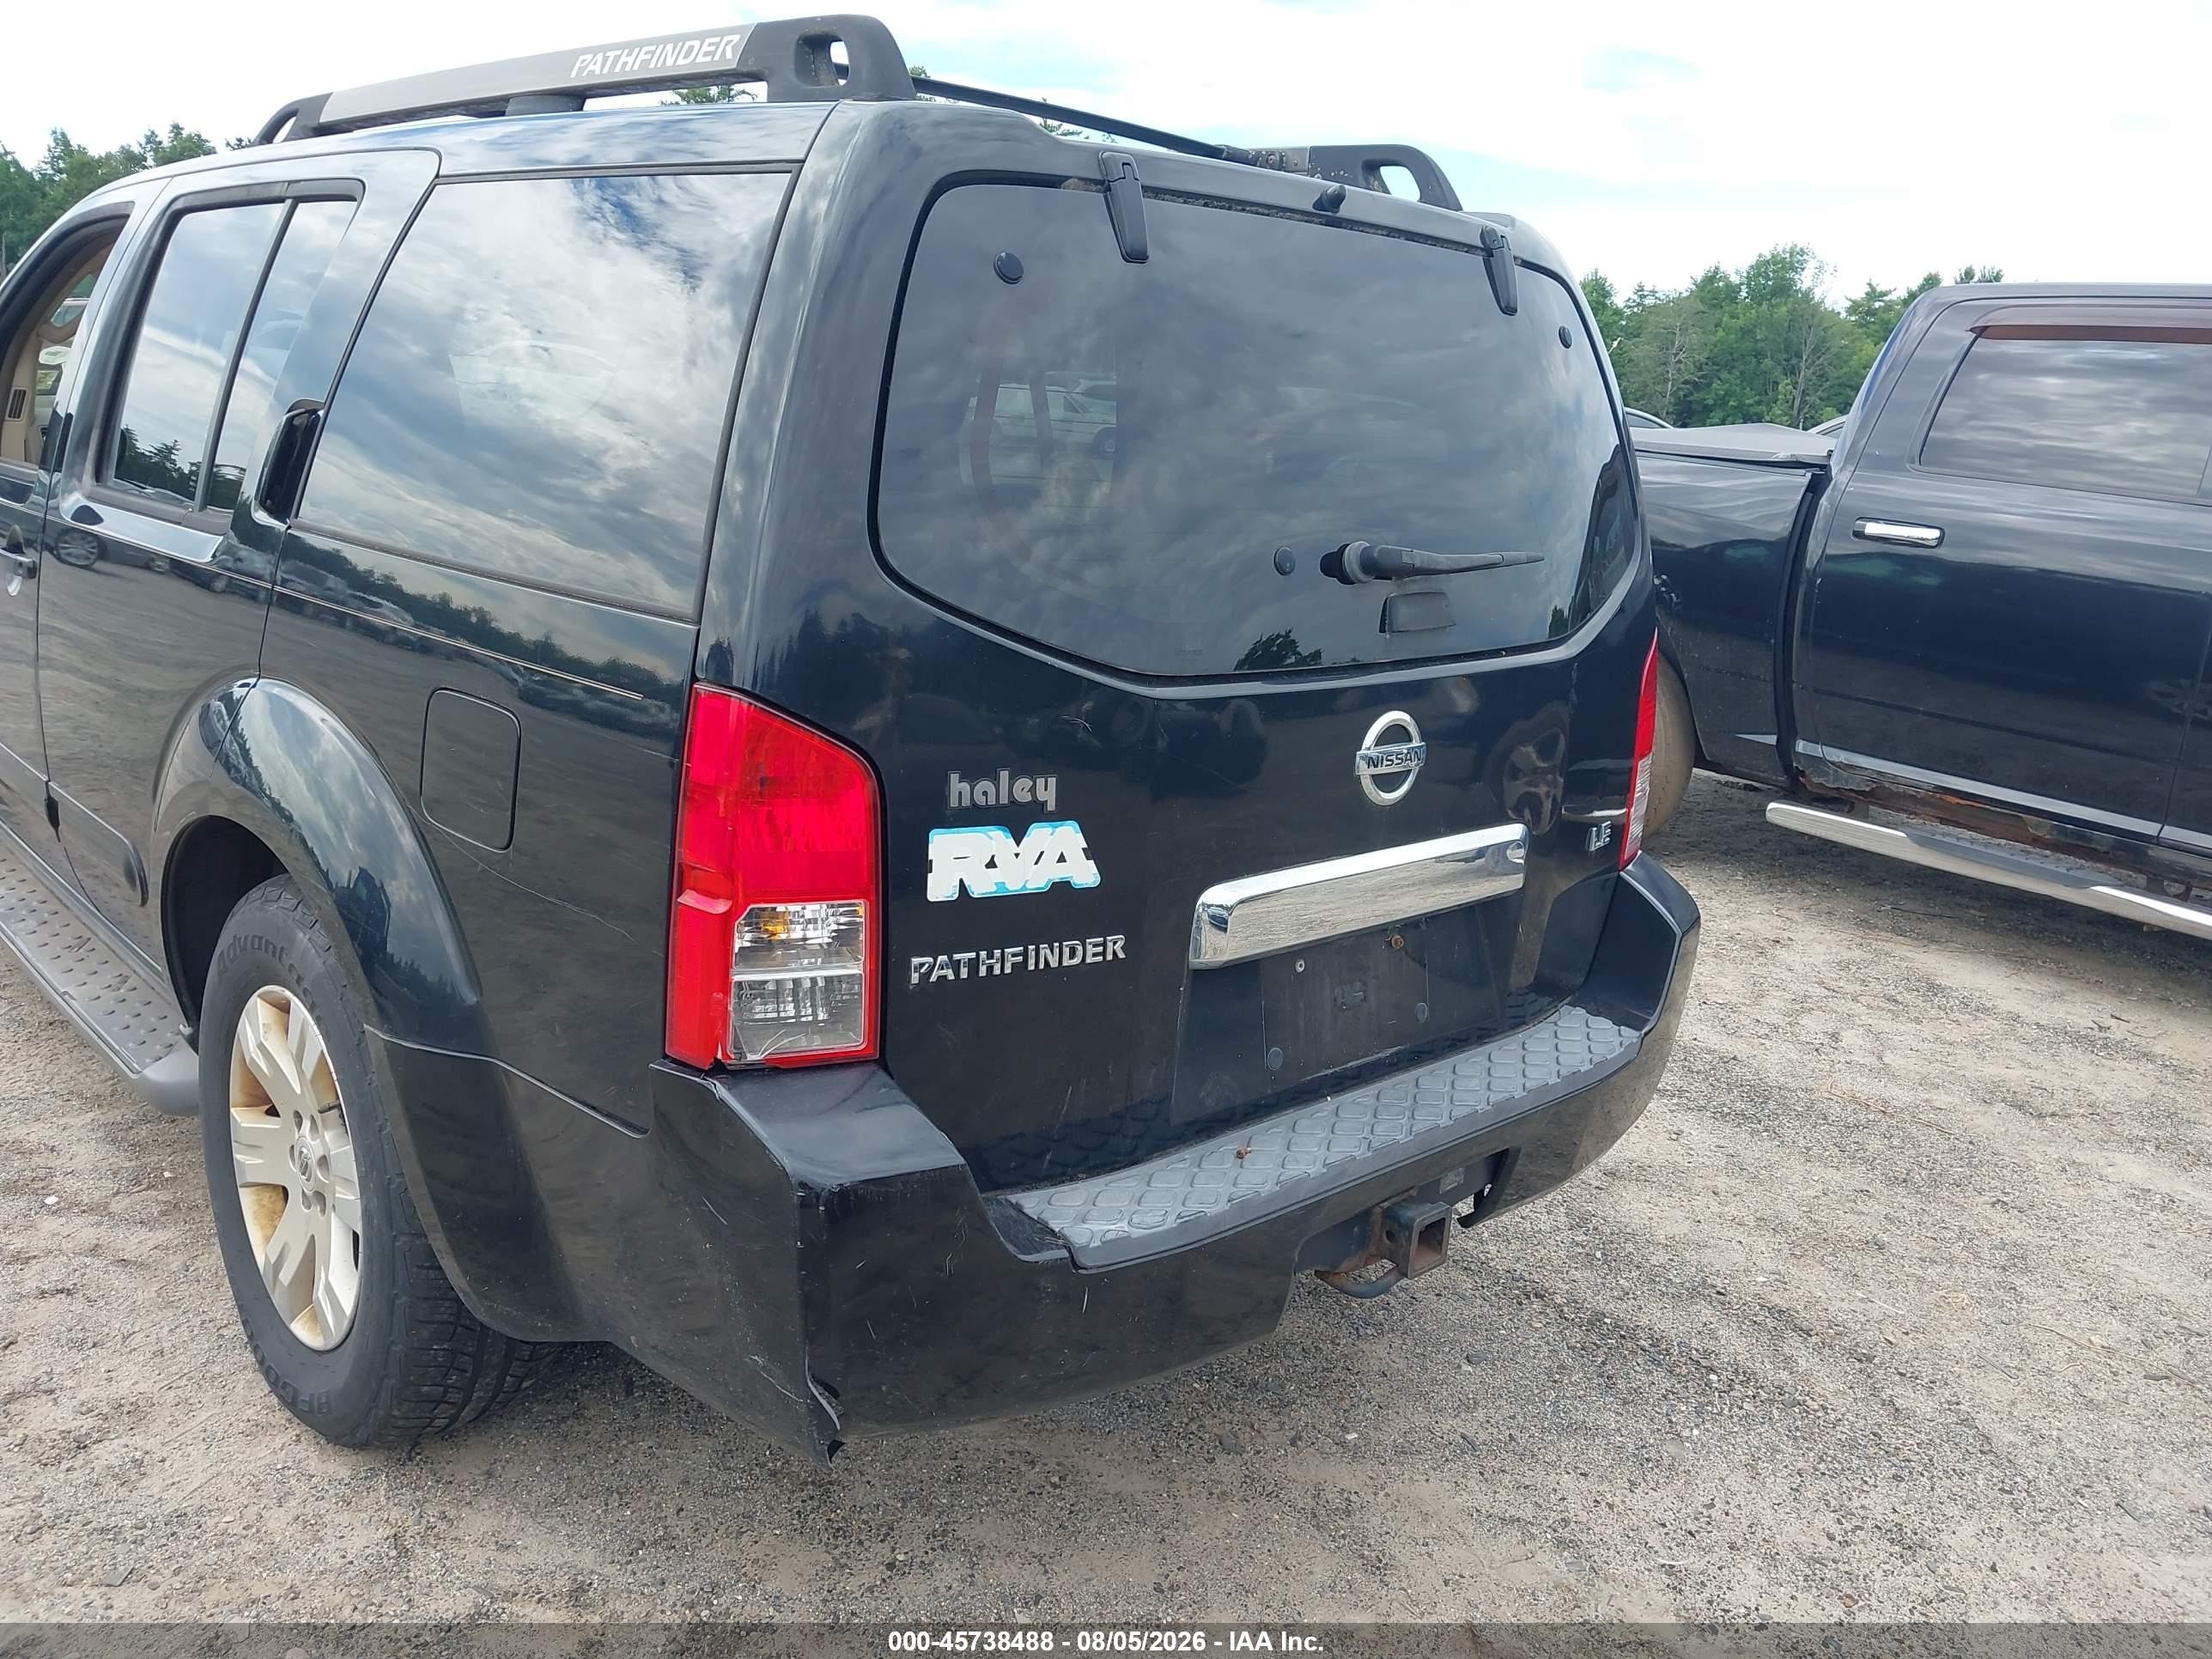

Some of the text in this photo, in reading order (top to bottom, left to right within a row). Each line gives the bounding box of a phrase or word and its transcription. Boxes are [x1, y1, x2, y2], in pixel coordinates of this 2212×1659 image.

[570, 33, 741, 78] PATHFINDER
[1366, 747, 1422, 769] NISSAN
[948, 769, 1057, 813] haley
[1586, 820, 1612, 852] LE
[927, 820, 1101, 902] RVA
[909, 934, 1127, 985] PATHFINDER
